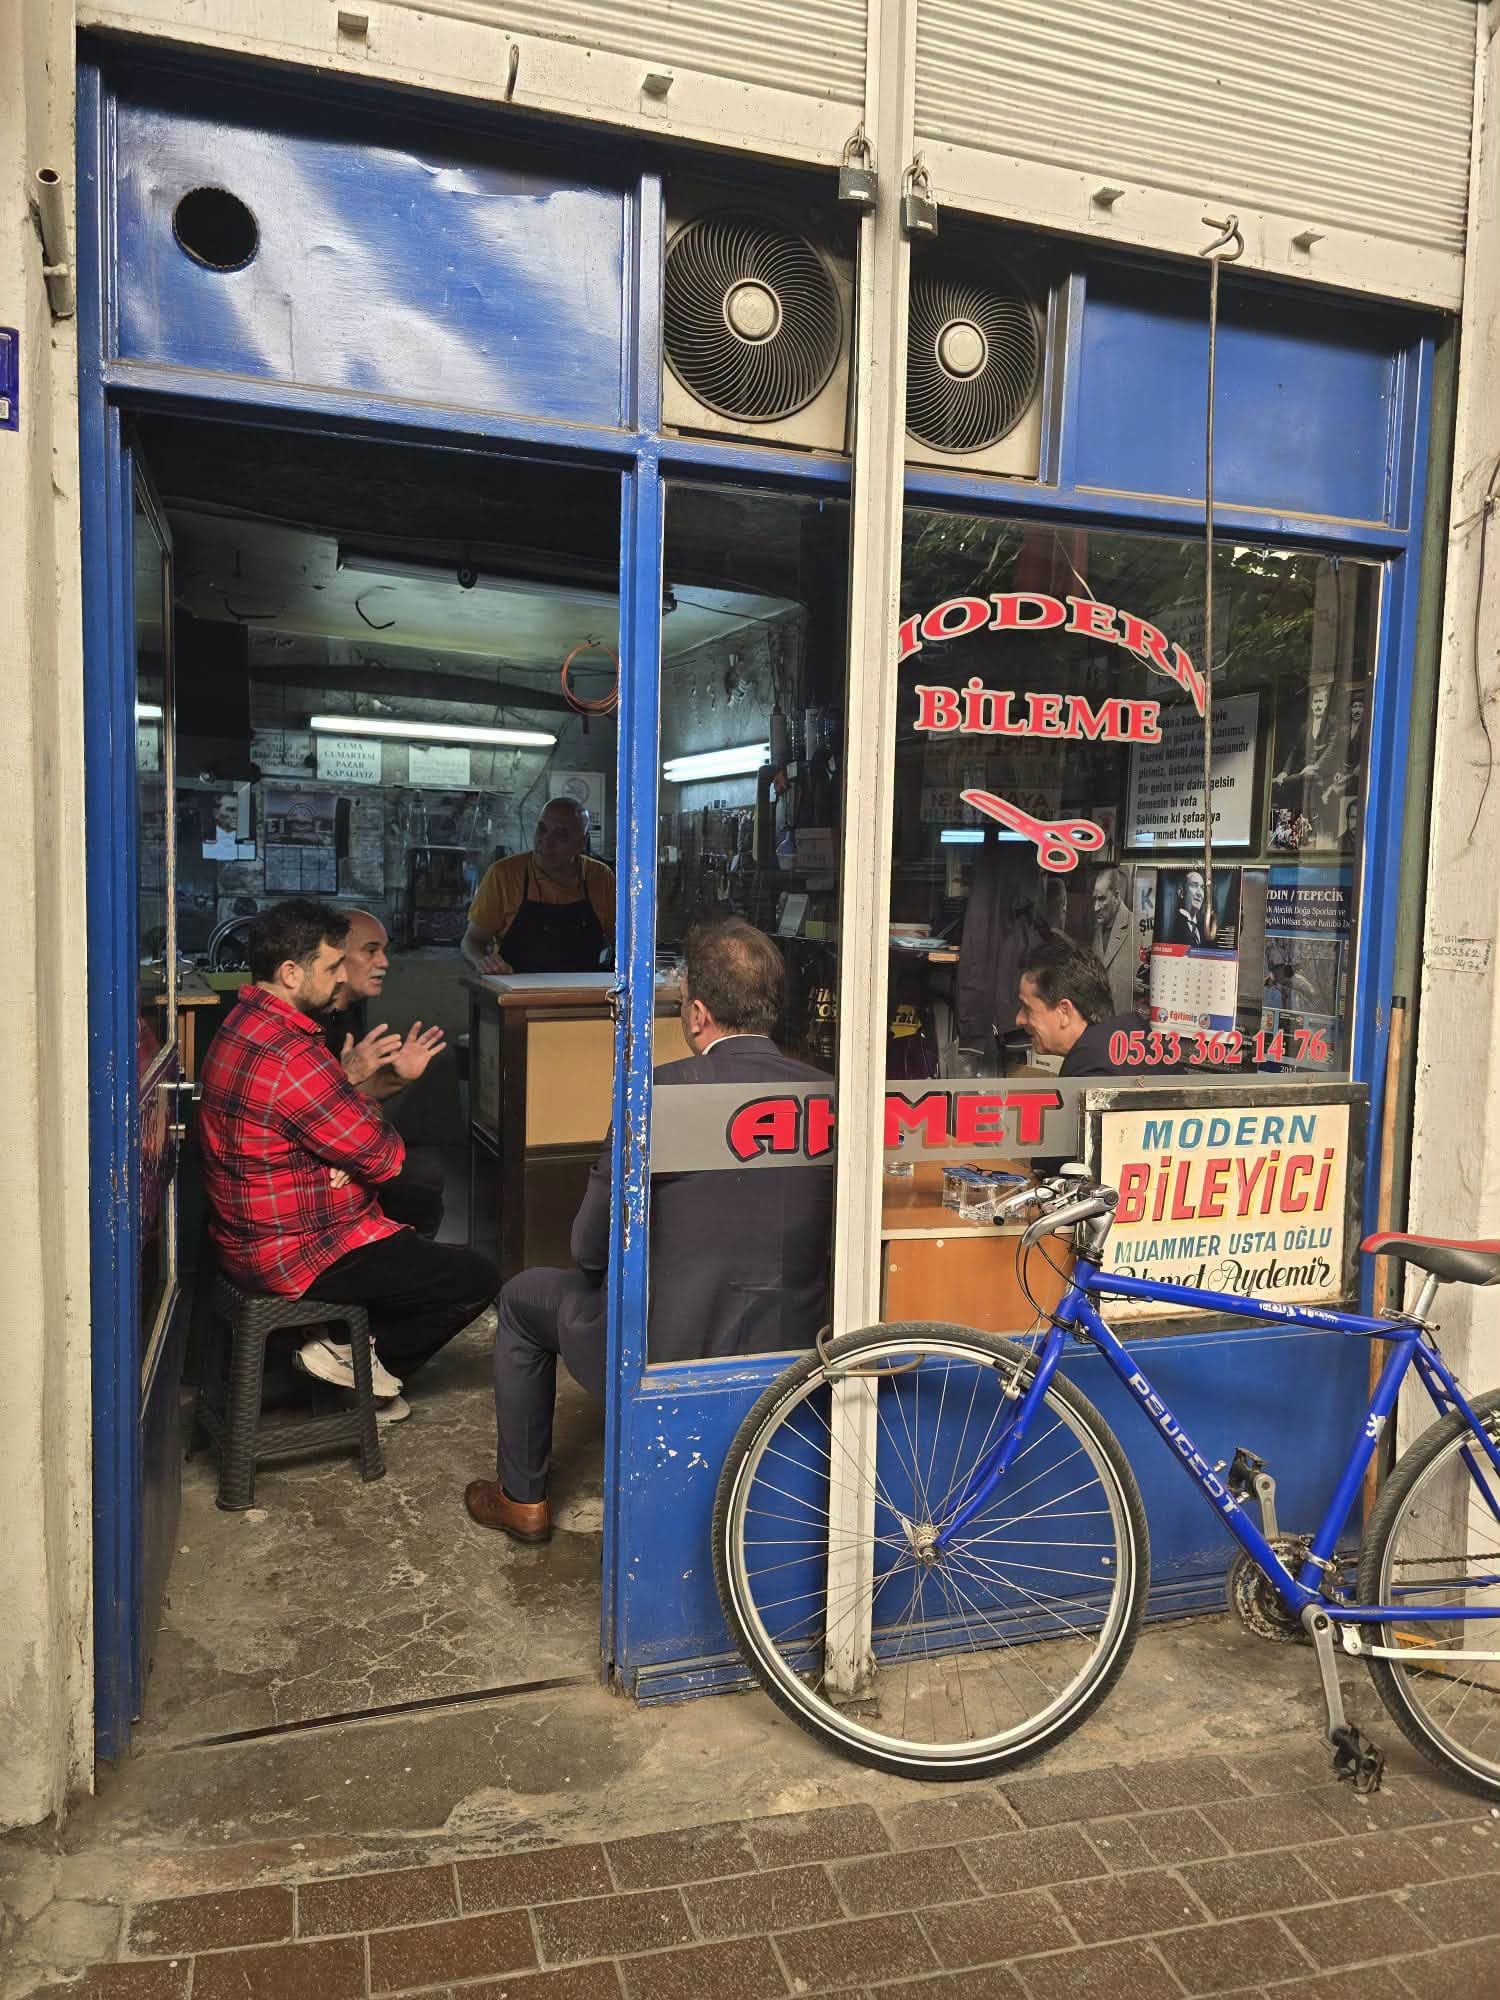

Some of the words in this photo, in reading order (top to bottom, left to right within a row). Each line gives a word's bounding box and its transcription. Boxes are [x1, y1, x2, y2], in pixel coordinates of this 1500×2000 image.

[914, 677, 1162, 744] BİLEME
[1211, 776, 1235, 792] gelsin
[1183, 811, 1207, 827] şefaa
[1296, 888, 1344, 902] TEPECİK
[1109, 1030, 1182, 1065] 0533
[1189, 1030, 1243, 1065] 362
[1252, 1029, 1285, 1064] 14
[1293, 1028, 1328, 1062] 76
[1142, 1114, 1316, 1150] MODERN
[1113, 1148, 1334, 1223] BİLEYİCİ
[1114, 1234, 1221, 1263] MUAMMER
[1228, 1231, 1277, 1255] USTA
[1284, 1225, 1333, 1250] OĞLU
[1208, 1256, 1337, 1297] Aydemir
[1128, 1372, 1240, 1513] PEUGEOT
